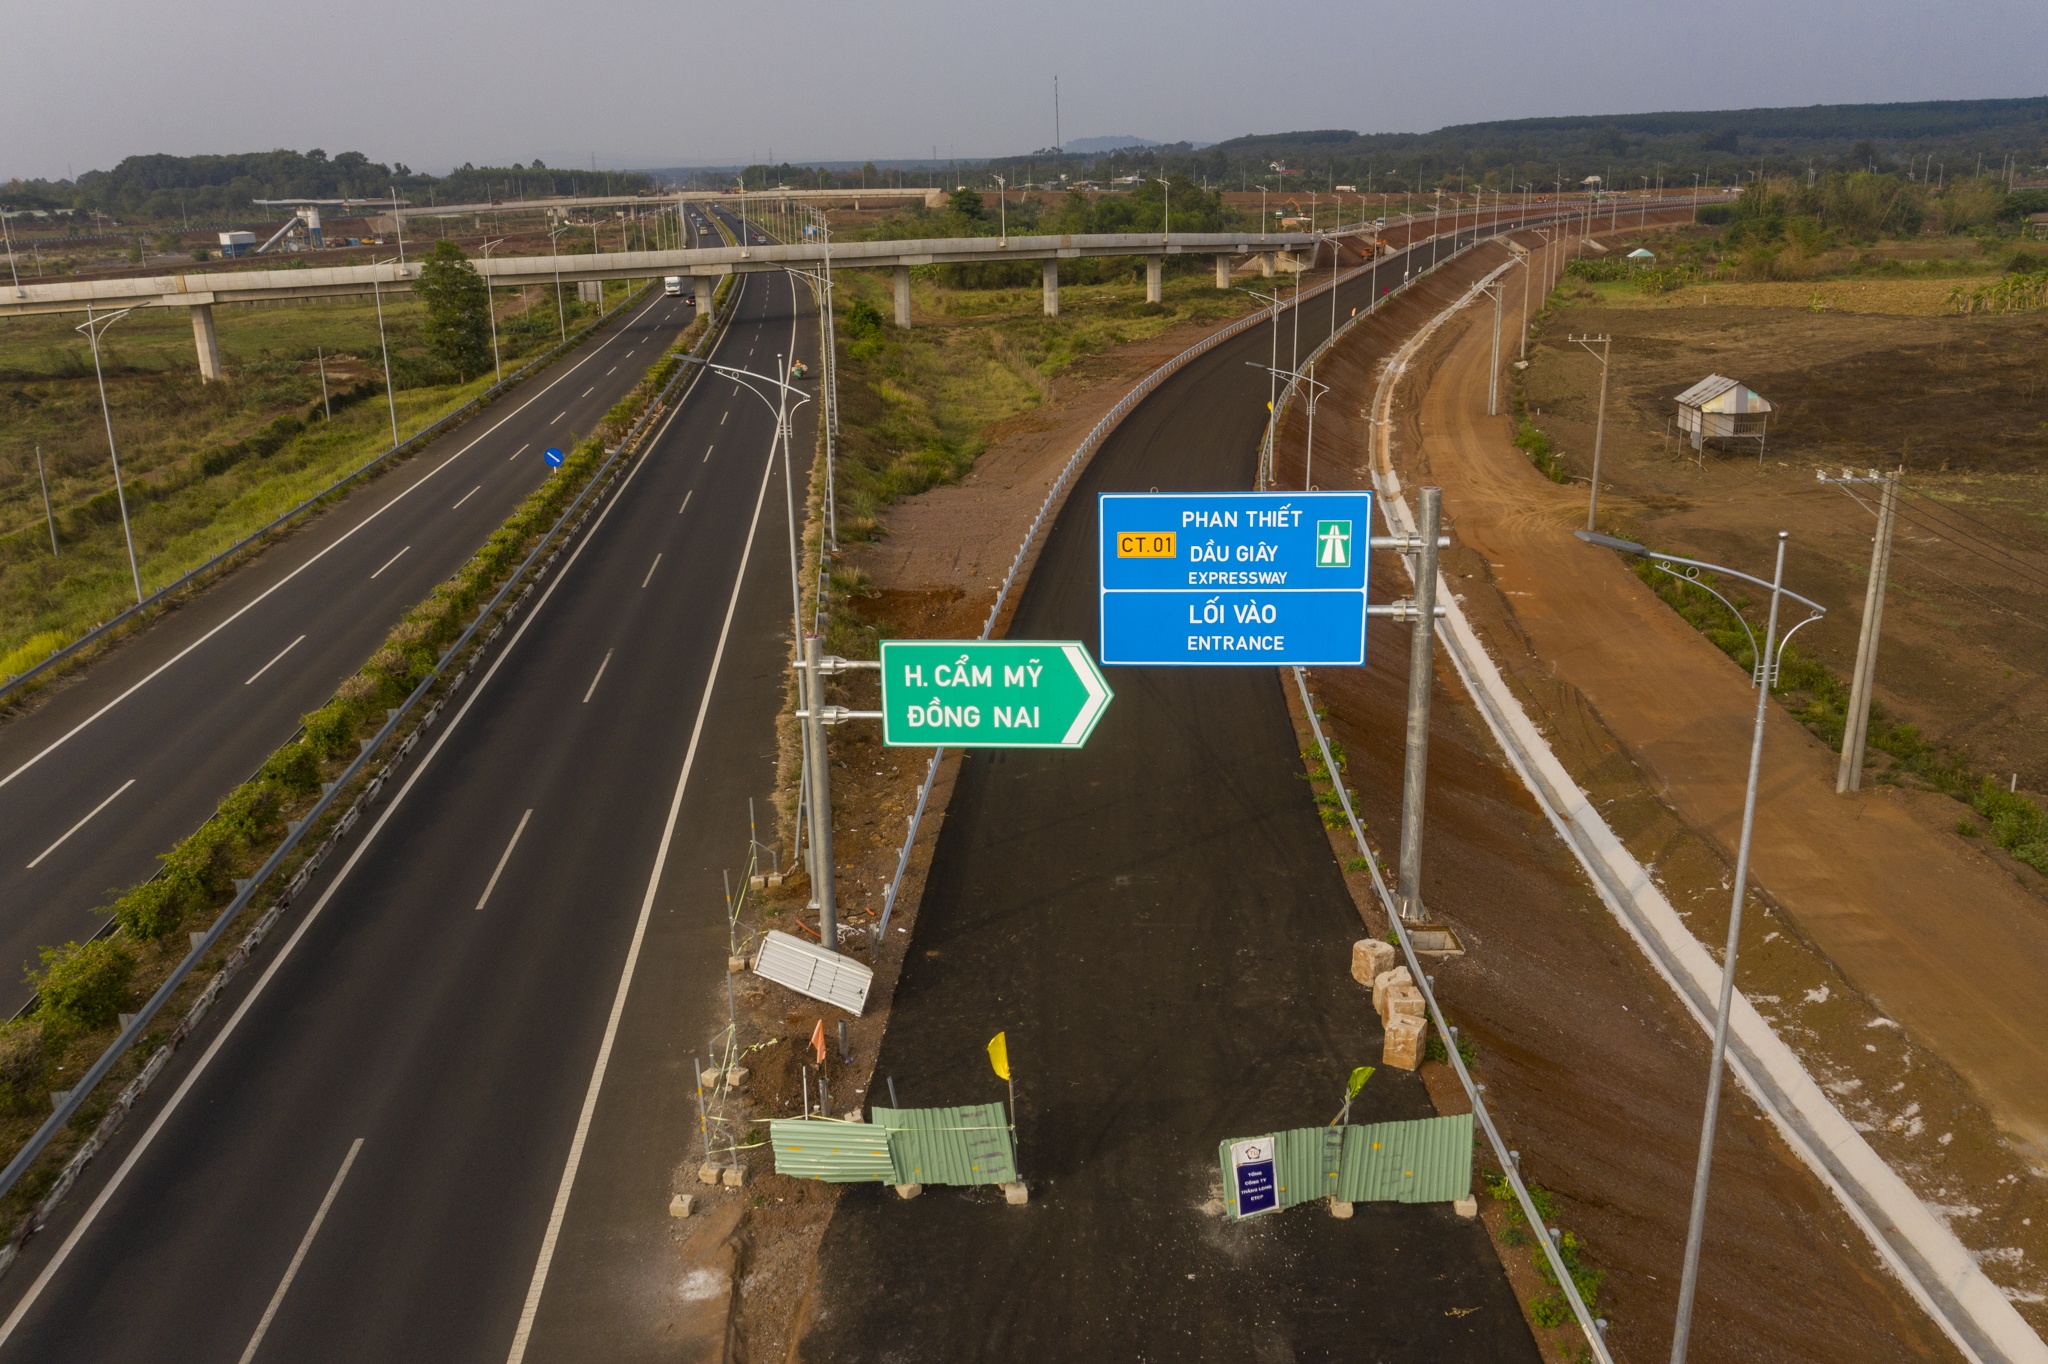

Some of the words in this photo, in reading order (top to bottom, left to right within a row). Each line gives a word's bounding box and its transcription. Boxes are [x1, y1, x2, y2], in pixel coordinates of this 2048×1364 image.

[1182, 511, 1238, 528] PHAN
[1246, 503, 1303, 528] THIẾT
[1121, 537, 1172, 553] CT.01
[1190, 539, 1229, 562] DẦU
[1236, 541, 1279, 562] GIÂY
[1188, 571, 1288, 585] EXPRESSWAY
[1189, 596, 1225, 624] LỐI
[1233, 599, 1277, 624] VÀO
[1187, 636, 1285, 651] ENTRANCE
[904, 665, 928, 687] H.
[935, 654, 992, 687] CẨM
[1004, 659, 1043, 688] MỸ
[907, 696, 981, 728] ĐỒNG
[994, 706, 1040, 728] NAI
